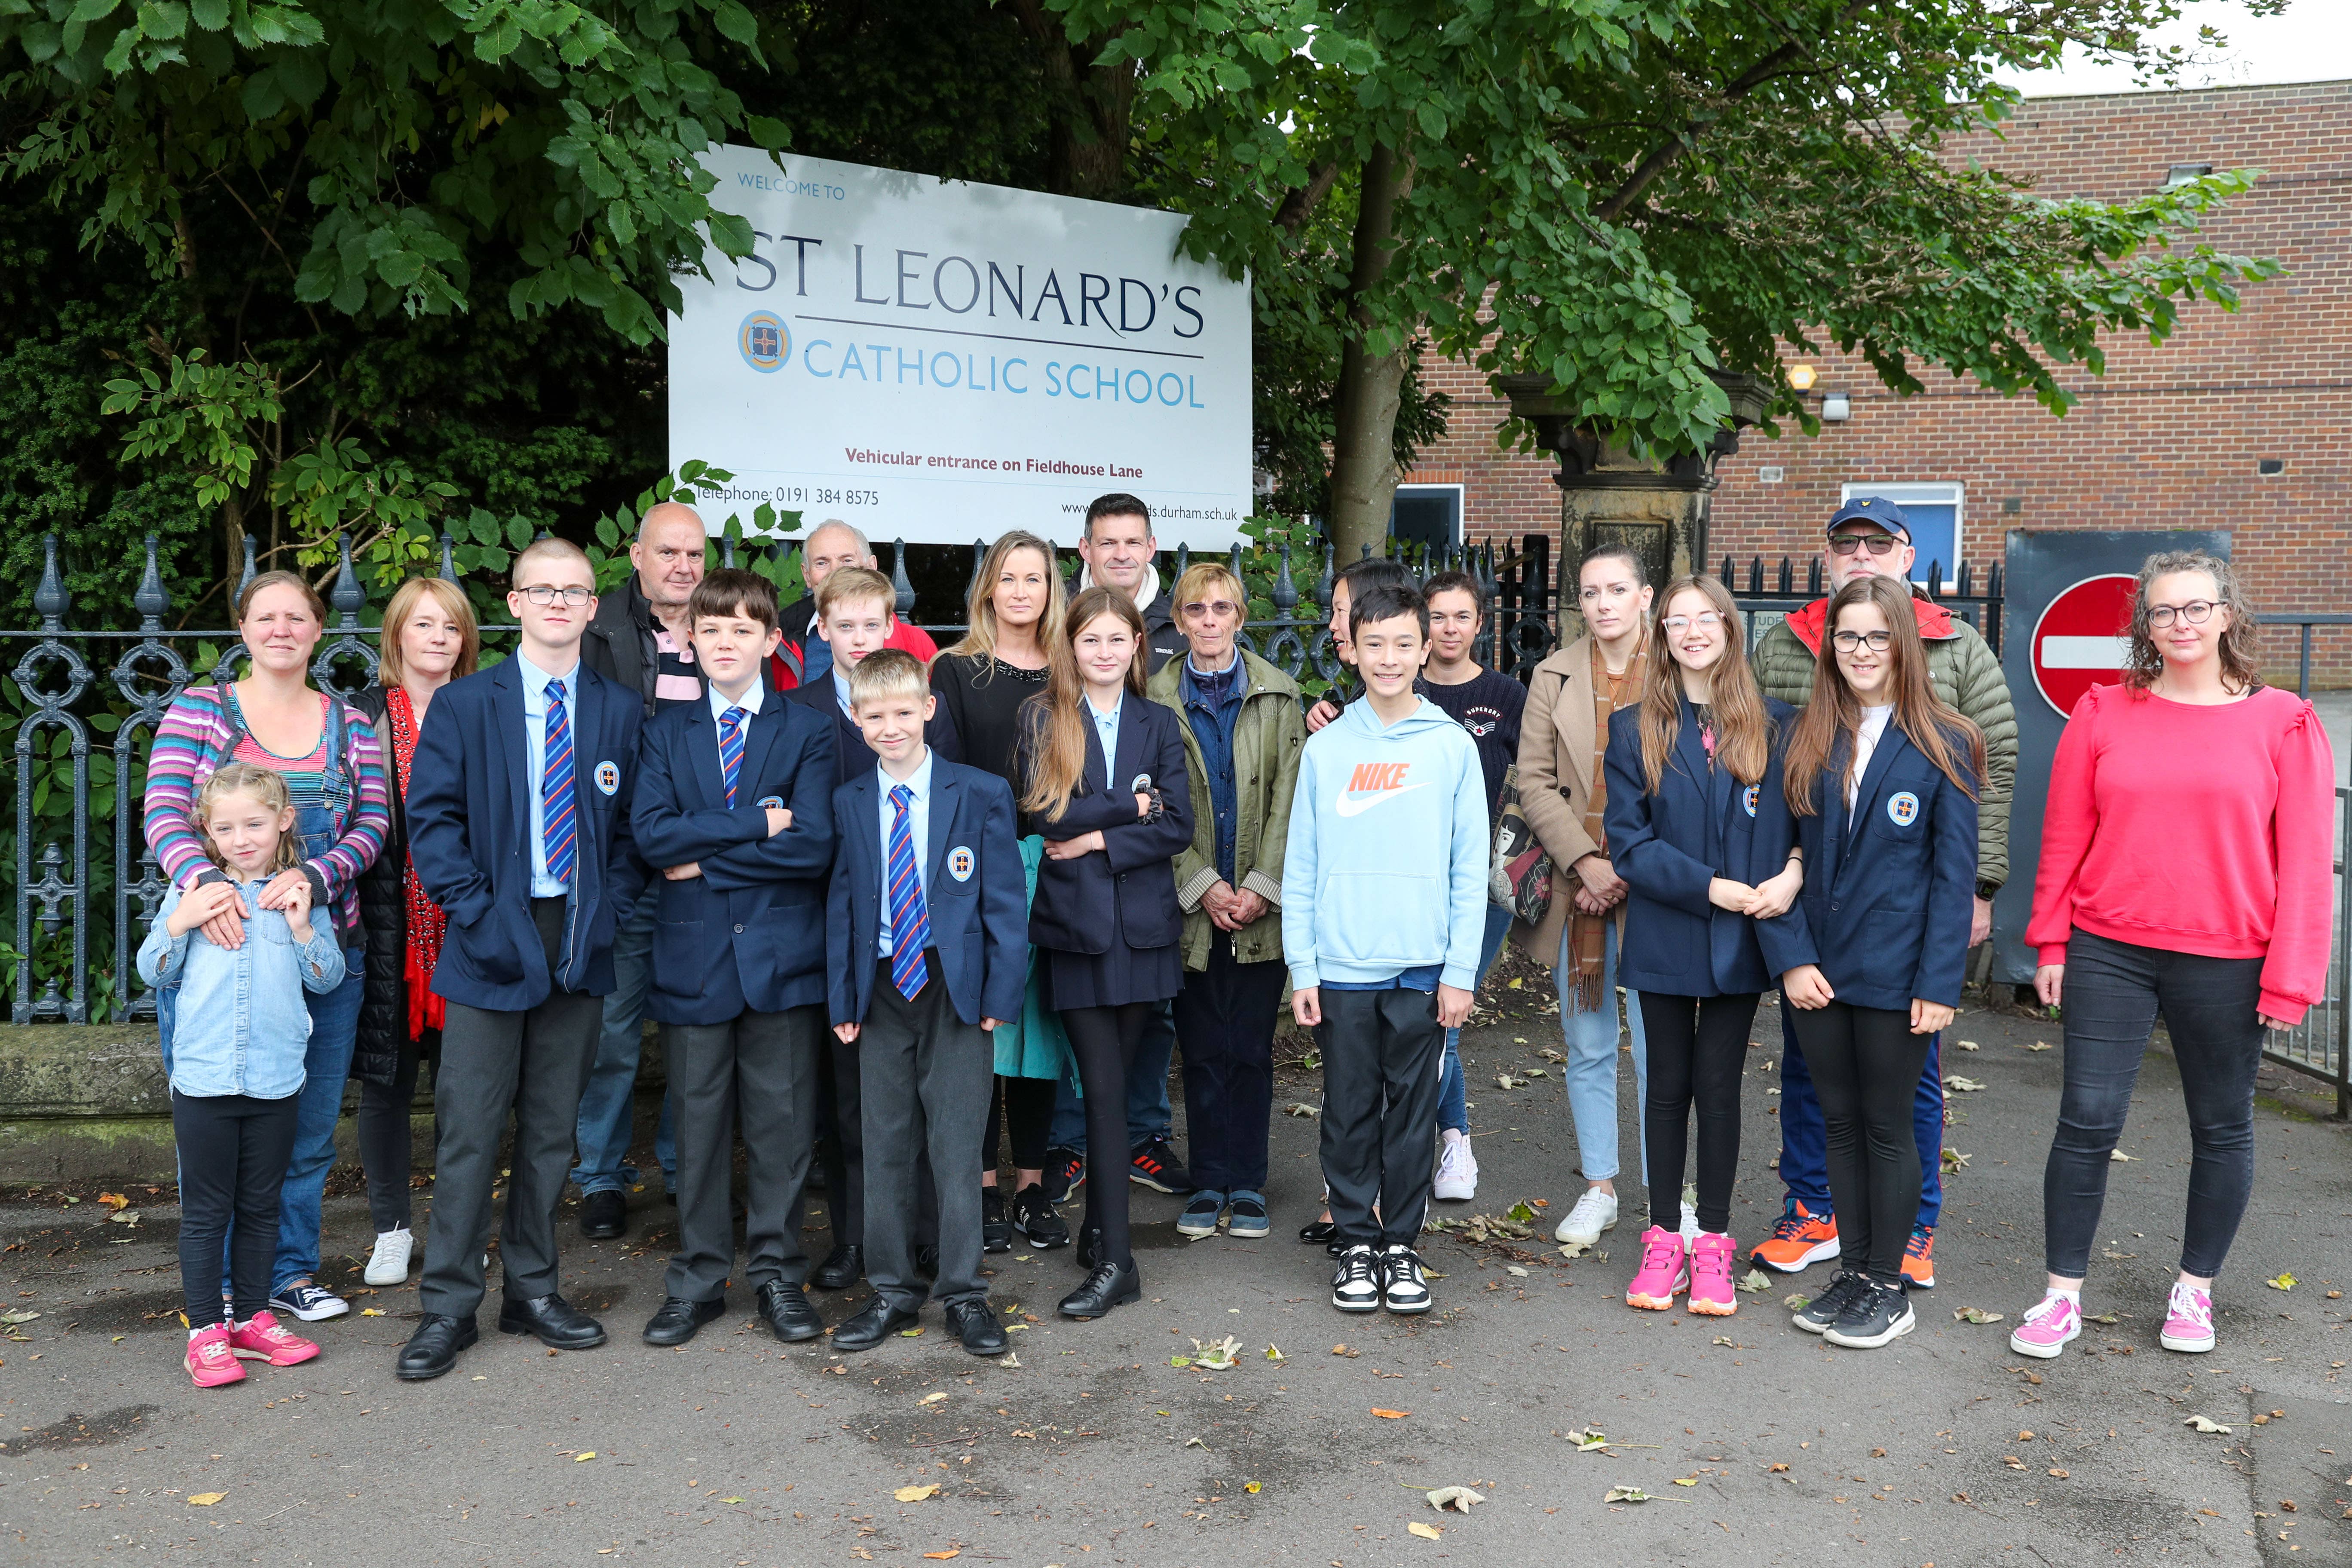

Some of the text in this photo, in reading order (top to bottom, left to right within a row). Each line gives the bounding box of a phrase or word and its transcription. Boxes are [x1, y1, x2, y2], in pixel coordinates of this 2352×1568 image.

[738, 172, 845, 200] WELCOME TO
[736, 231, 1204, 339] ST LEONARD'S
[804, 339, 1205, 409] CATHOLIC SCHOOL
[845, 447, 1143, 478] Vehicular entrance on Fieldhouse Lane
[697, 486, 879, 505] Telephone: 0191 384 8575
[1466, 707, 1501, 718] SUPERDRY
[1348, 763, 1410, 792] NIKE
